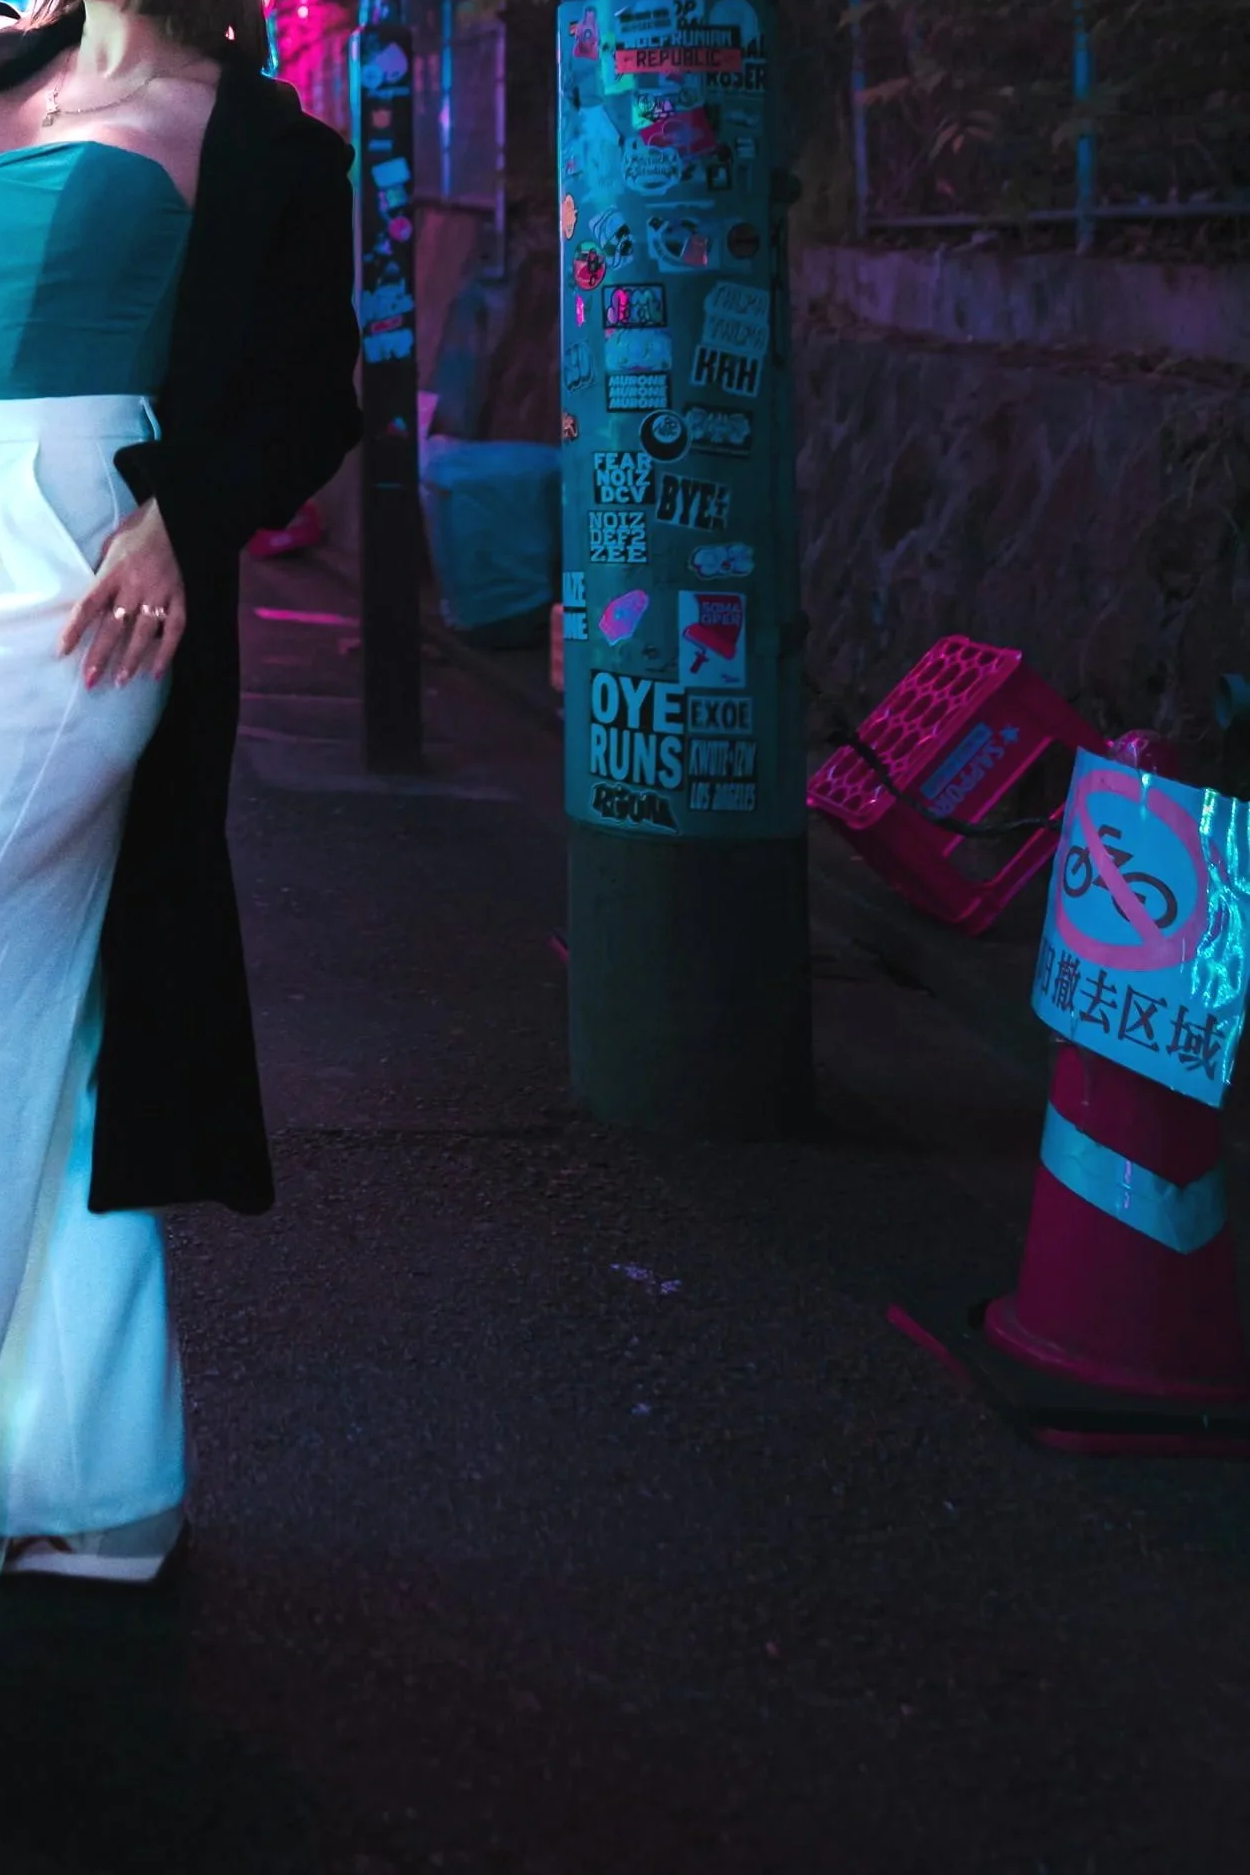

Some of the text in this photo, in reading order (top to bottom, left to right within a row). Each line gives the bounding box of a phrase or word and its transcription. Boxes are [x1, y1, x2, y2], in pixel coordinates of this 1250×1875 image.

[636, 49, 722, 68] REPUBLIC
[593, 452, 652, 470] FEAR
[596, 468, 650, 486] NOIZ
[601, 485, 646, 503] DCV
[588, 511, 645, 529] NOIZ
[590, 545, 647, 562] ZEE
[591, 672, 686, 735] OYE
[590, 723, 684, 790] RUNS
